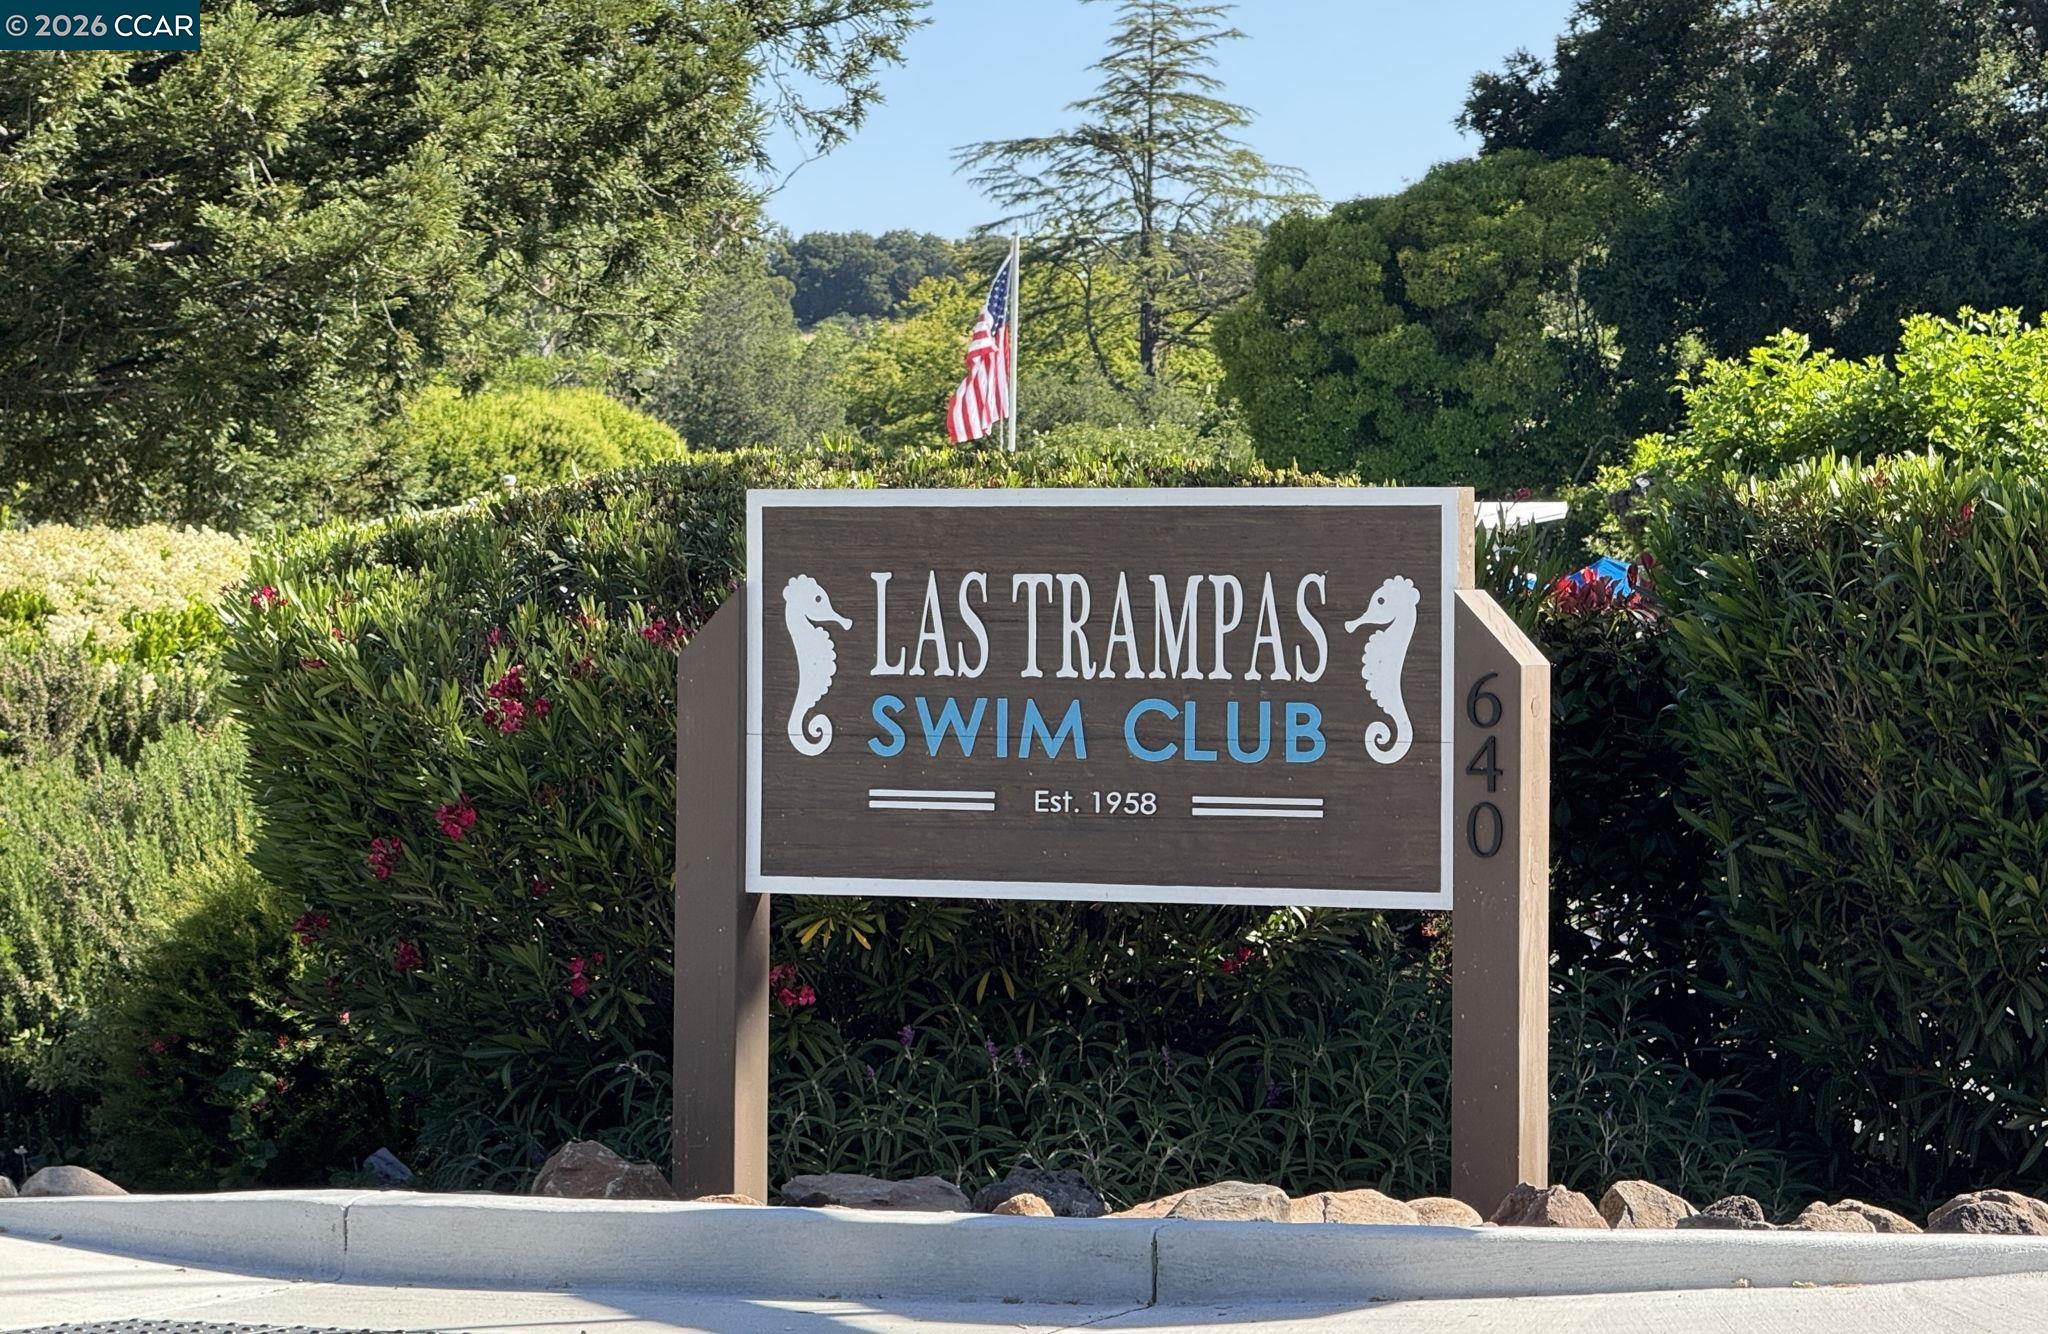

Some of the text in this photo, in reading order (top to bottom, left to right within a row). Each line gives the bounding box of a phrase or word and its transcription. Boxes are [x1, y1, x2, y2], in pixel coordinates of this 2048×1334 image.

[869, 570, 1328, 683] LAS TRAMPAS
[868, 694, 1326, 763] SWIM CLUB
[1466, 672, 1503, 858] 640
[1034, 790, 1158, 815] Est. 1958
